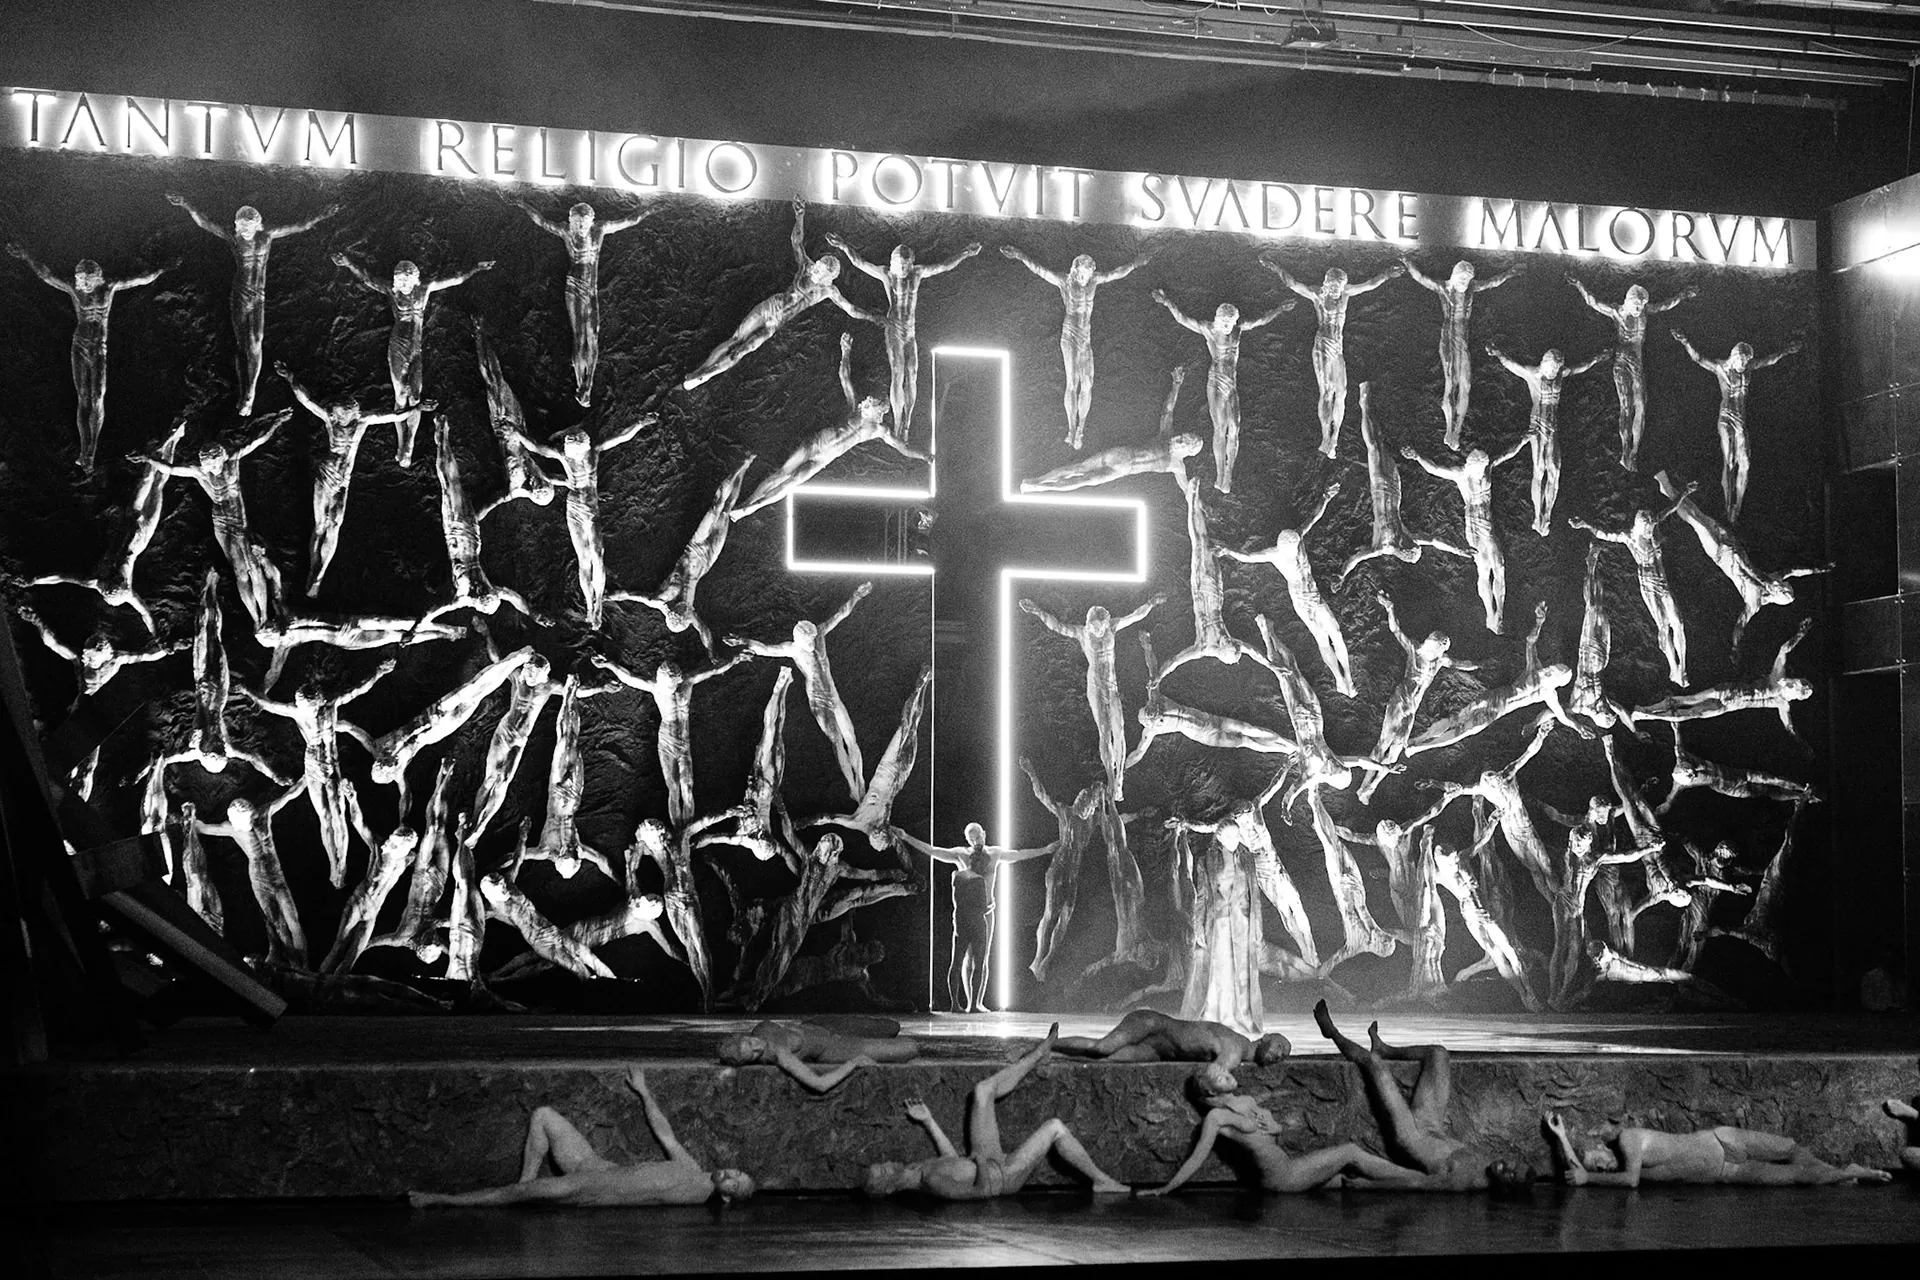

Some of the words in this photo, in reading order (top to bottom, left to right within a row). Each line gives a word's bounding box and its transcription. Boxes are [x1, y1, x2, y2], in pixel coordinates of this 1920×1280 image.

[12, 88, 358, 165] TANTVM
[435, 119, 758, 194] RELIGIO
[831, 150, 1095, 218] POTVIT
[1140, 173, 1420, 240] SVADERE
[1481, 199, 1795, 265] MALORVM
